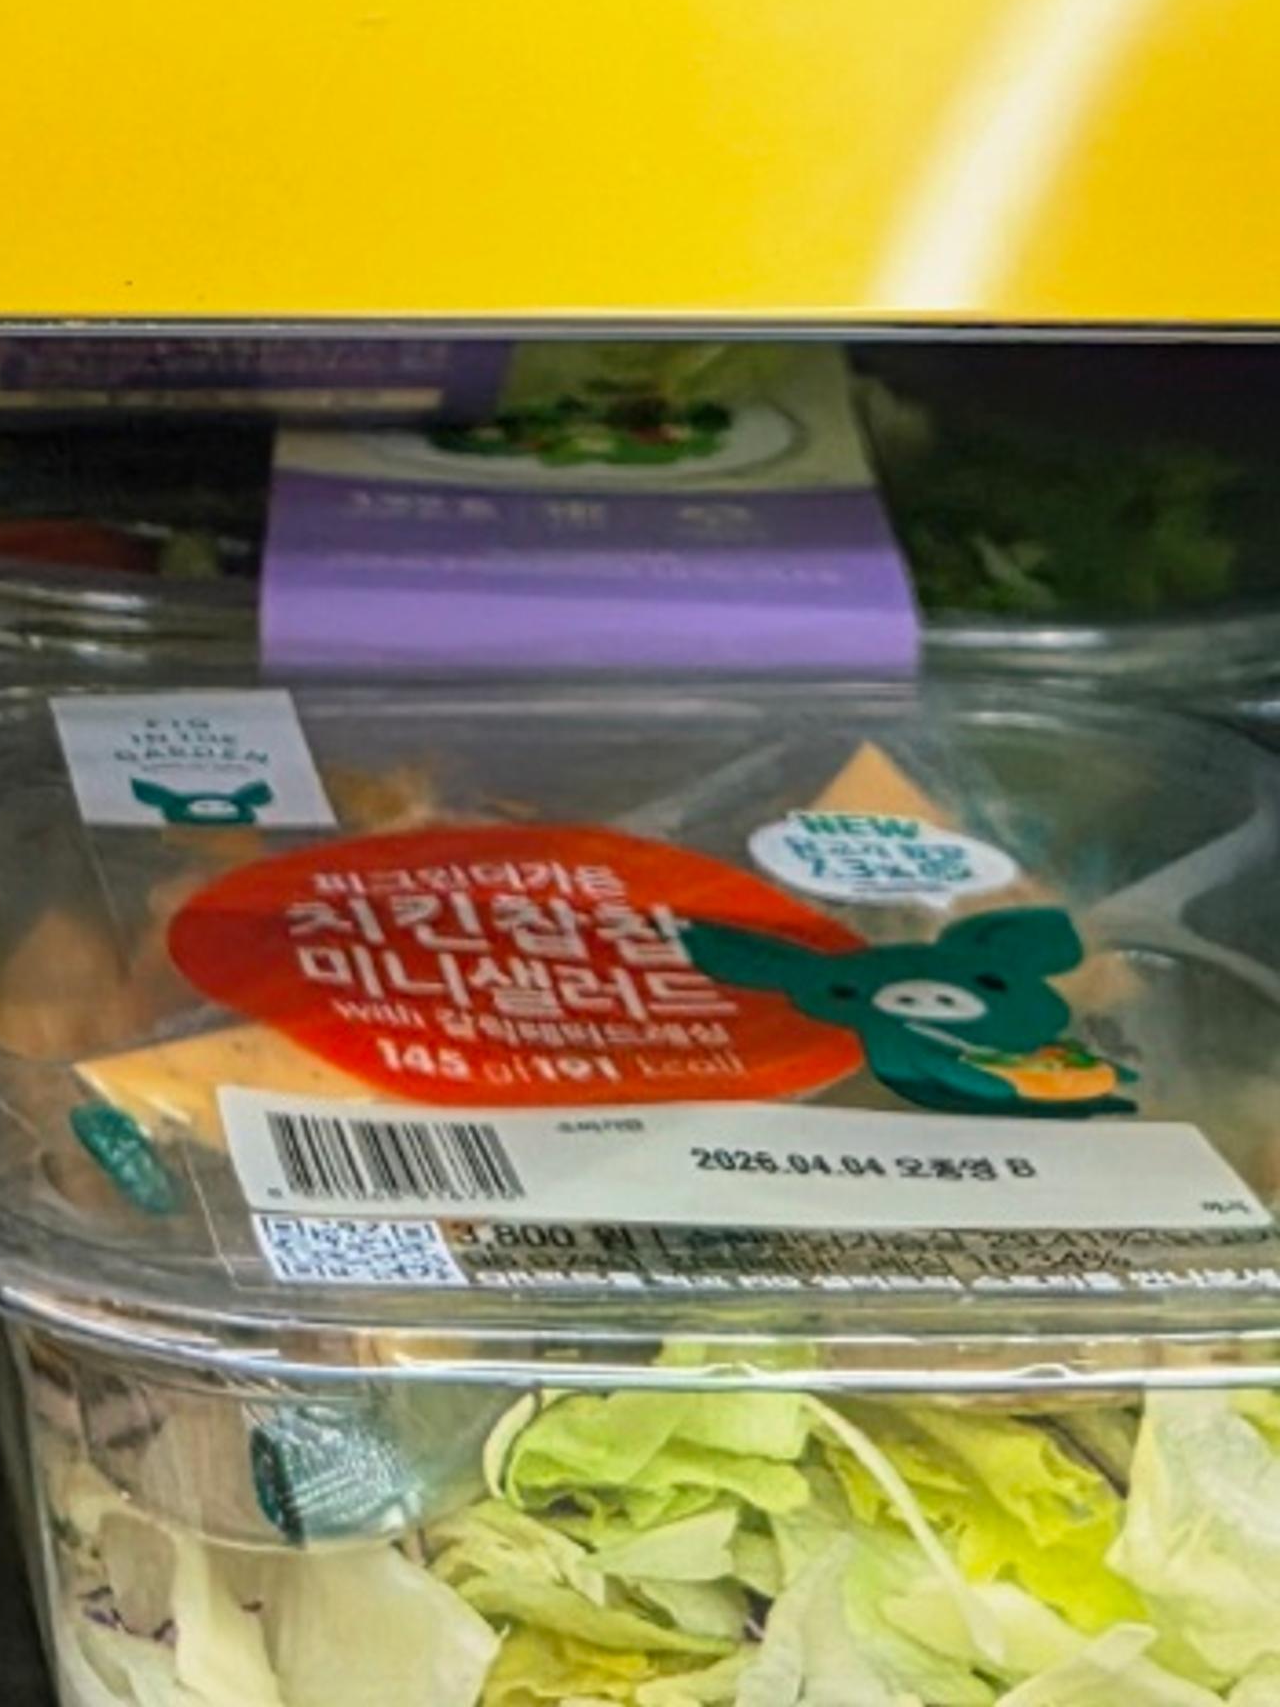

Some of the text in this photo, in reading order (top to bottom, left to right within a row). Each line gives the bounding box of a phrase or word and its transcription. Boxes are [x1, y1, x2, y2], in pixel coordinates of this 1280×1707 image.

[296, 944, 738, 1023] 미니샐러드
[376, 1037, 471, 1078] 145
[690, 1147, 887, 1177] 2026.04.04
